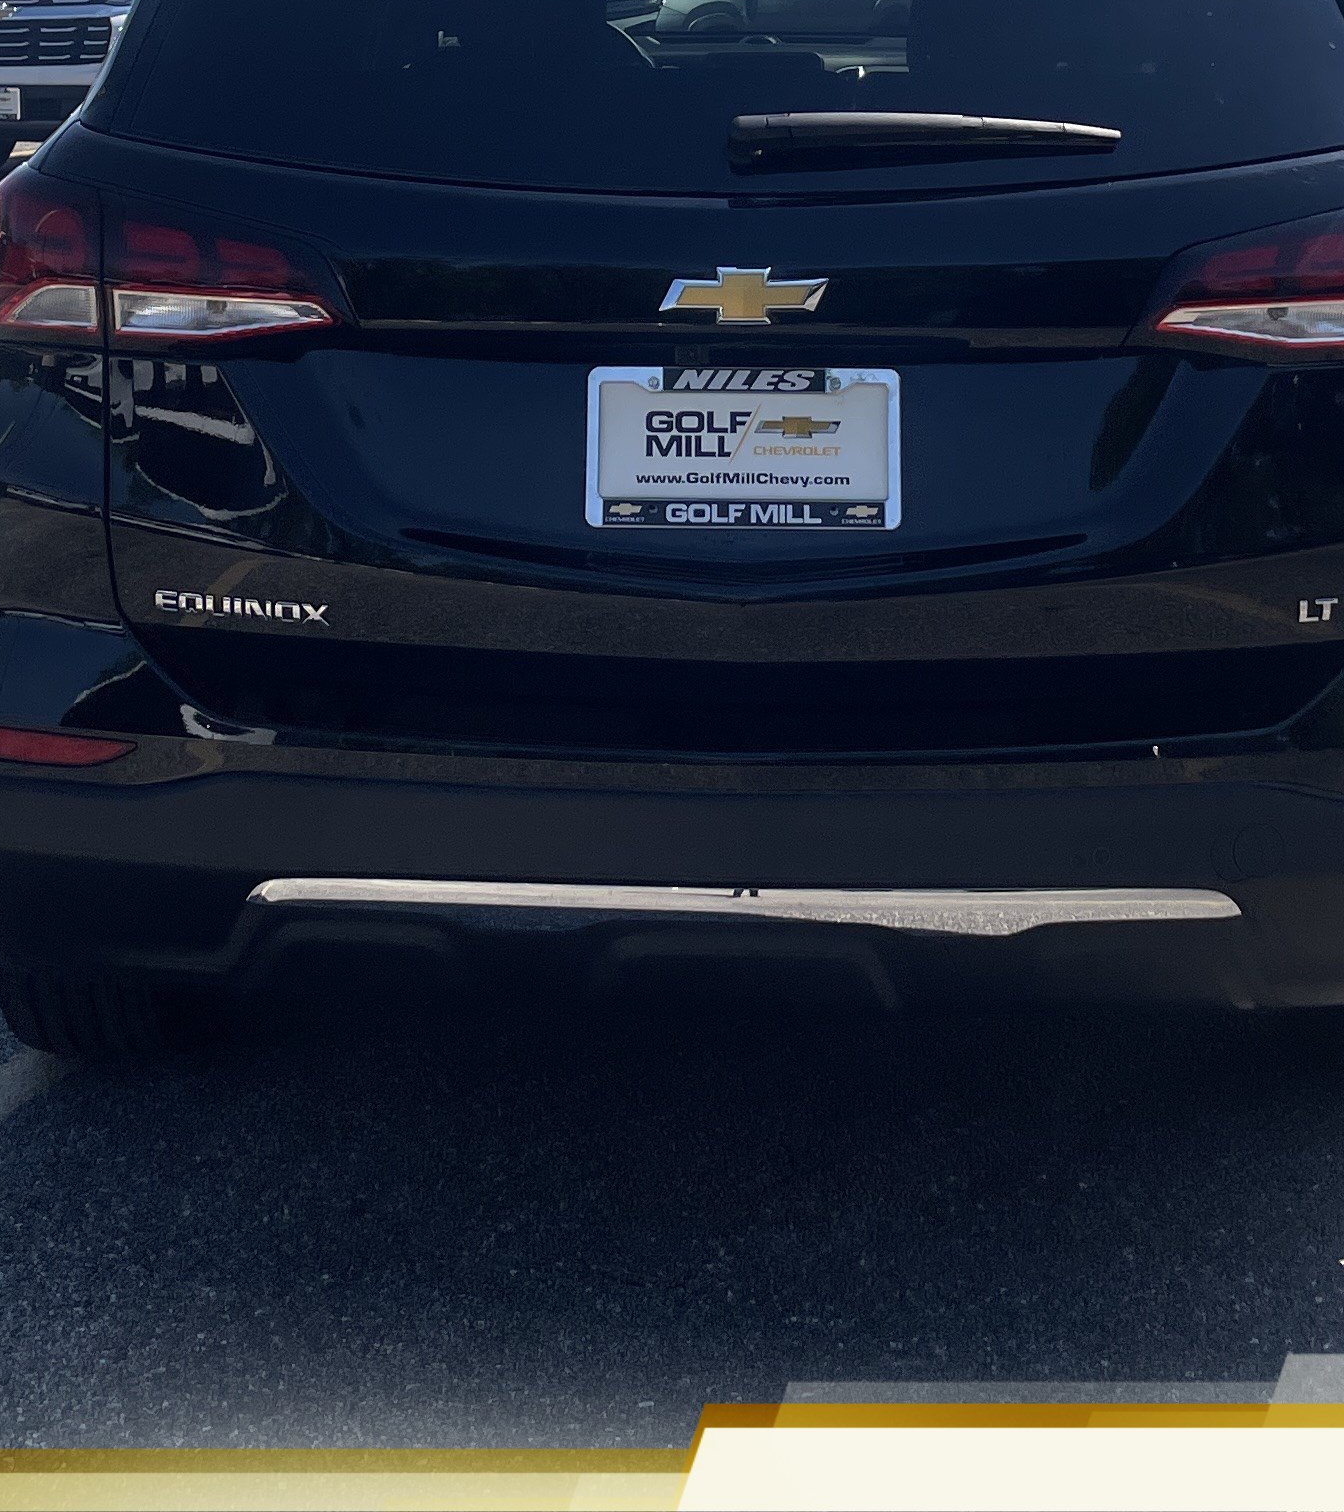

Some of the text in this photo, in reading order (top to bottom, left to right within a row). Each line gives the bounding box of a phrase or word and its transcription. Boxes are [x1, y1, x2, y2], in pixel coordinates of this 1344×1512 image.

[672, 369, 816, 391] NILES
[645, 411, 753, 434] GOLF
[645, 435, 732, 458] MILL
[753, 446, 842, 457] CHEVROLET
[636, 472, 851, 488] www.GolfMillChevy.com
[665, 503, 822, 525] GOLF MILL
[155, 589, 331, 627] EQUINOX
[1298, 597, 1339, 623] LT
